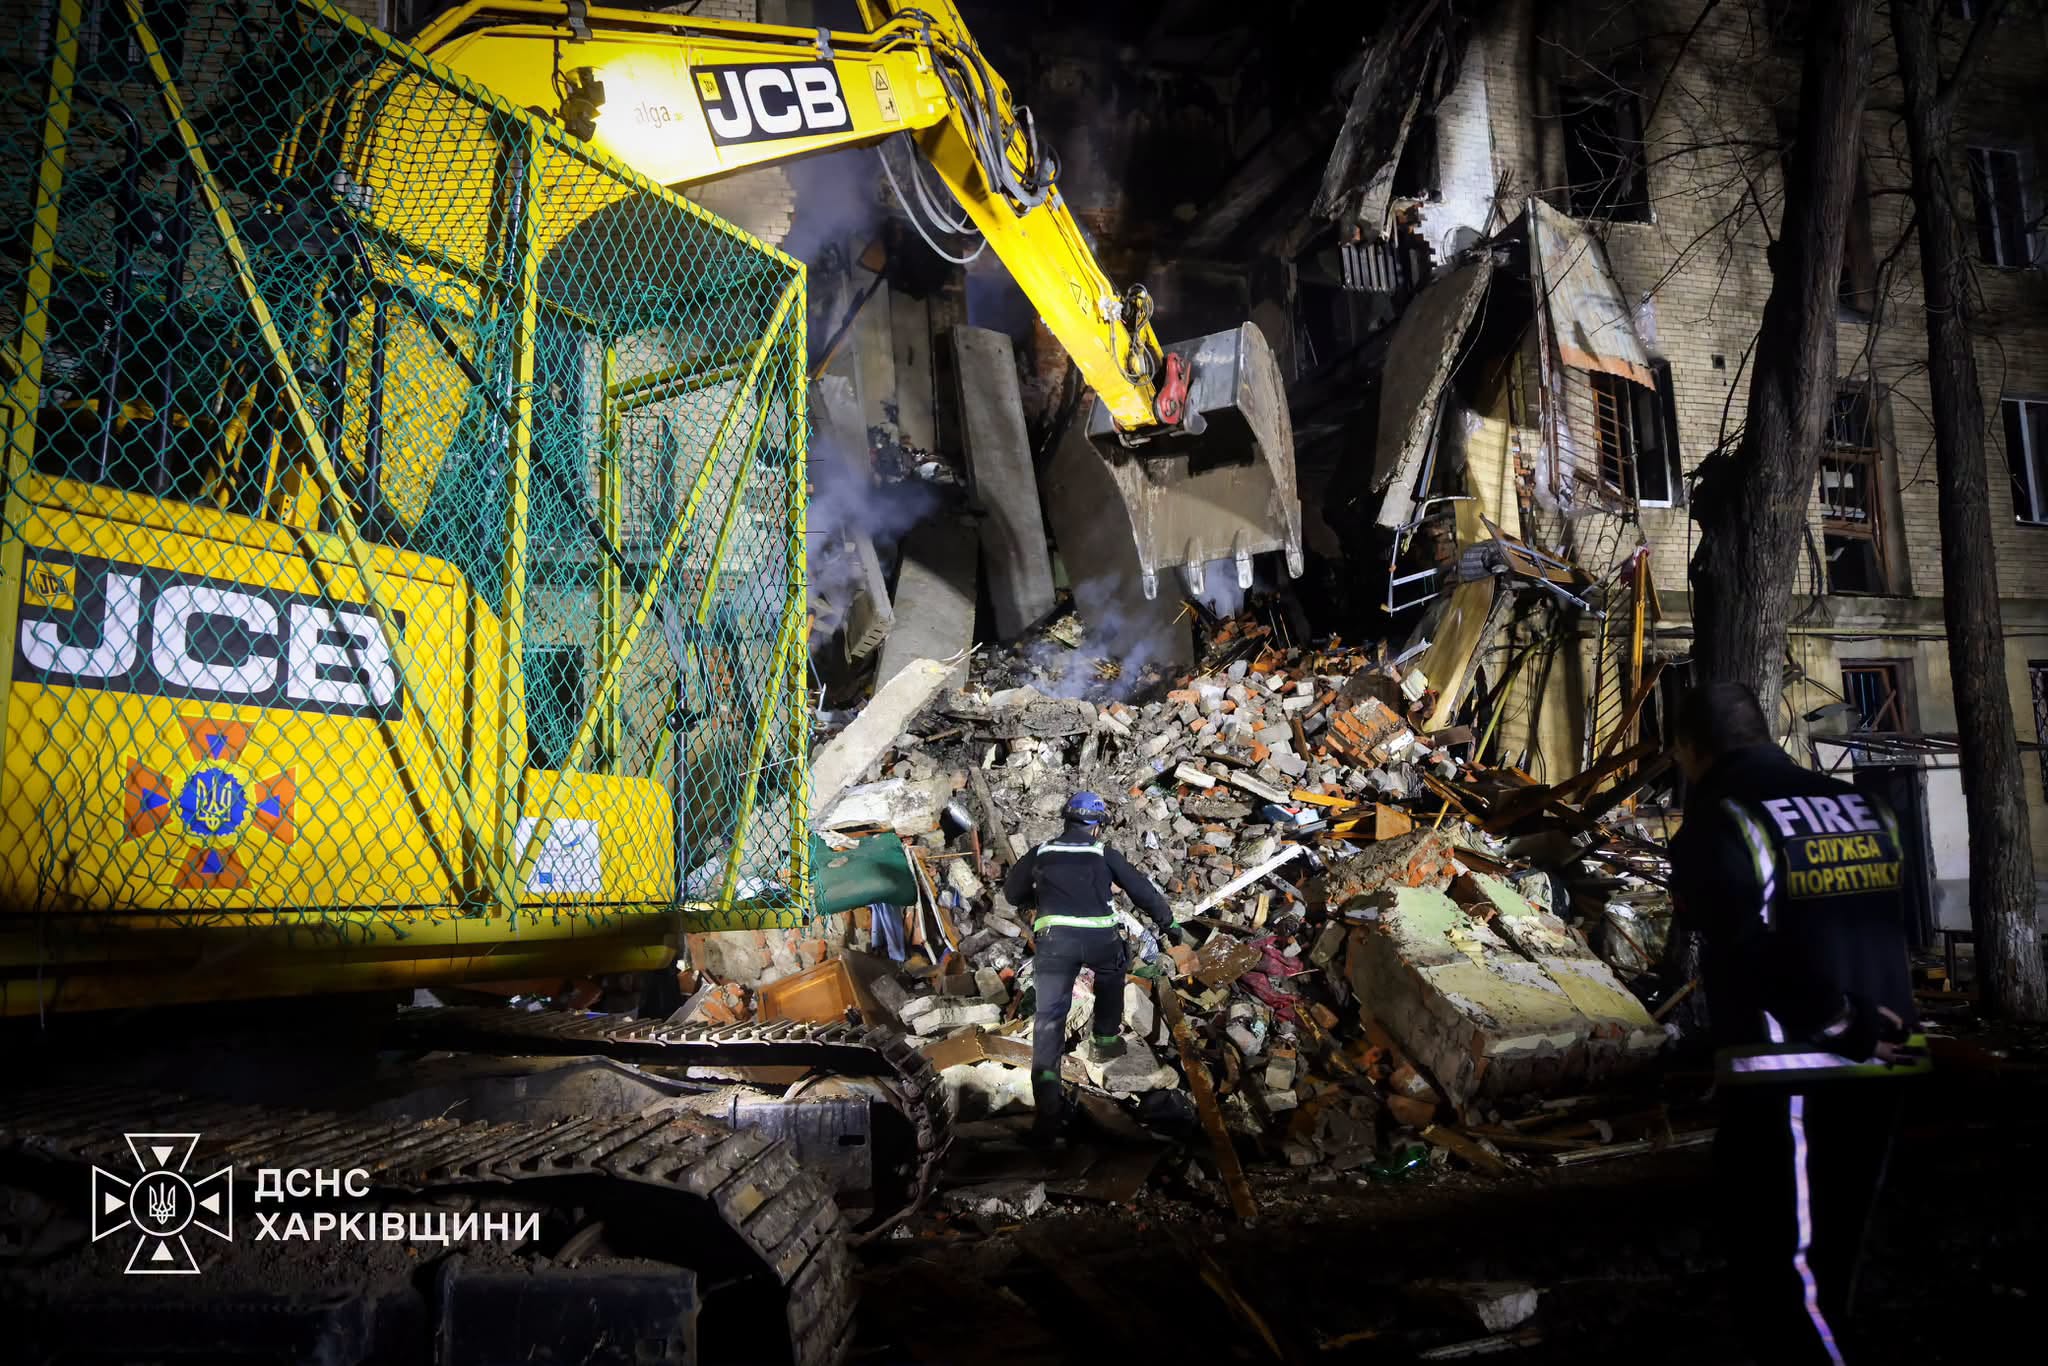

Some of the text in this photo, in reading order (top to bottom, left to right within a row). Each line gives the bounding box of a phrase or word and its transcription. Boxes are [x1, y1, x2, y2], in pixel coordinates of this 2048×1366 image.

[708, 67, 847, 139] JCB
[21, 573, 396, 706] JCB
[1761, 794, 1880, 837] FIRE
[1805, 835, 1881, 864] СЛУЖБА
[1790, 863, 1900, 895] ПОРЯТУНКУ
